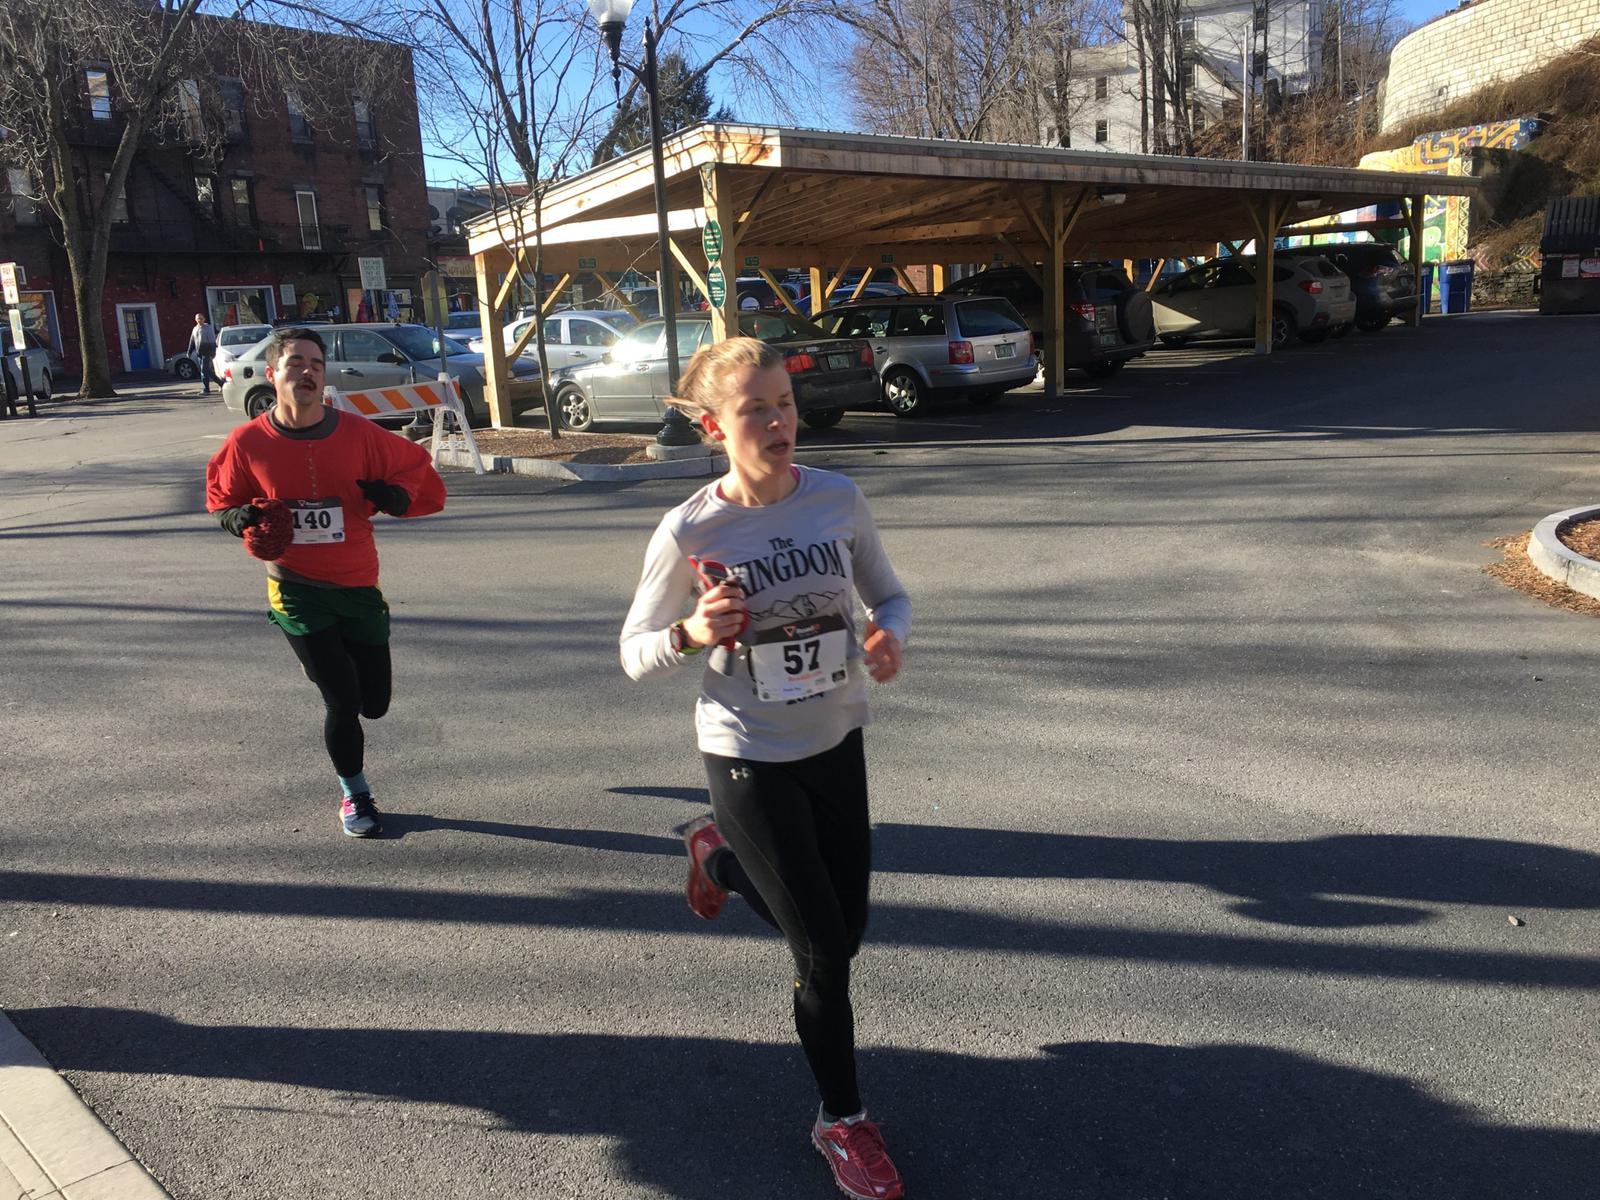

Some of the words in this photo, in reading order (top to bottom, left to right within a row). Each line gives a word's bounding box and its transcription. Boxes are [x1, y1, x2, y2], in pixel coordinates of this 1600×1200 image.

[292, 511, 331, 529] 140
[768, 537, 795, 551] The
[784, 640, 819, 675] 57
